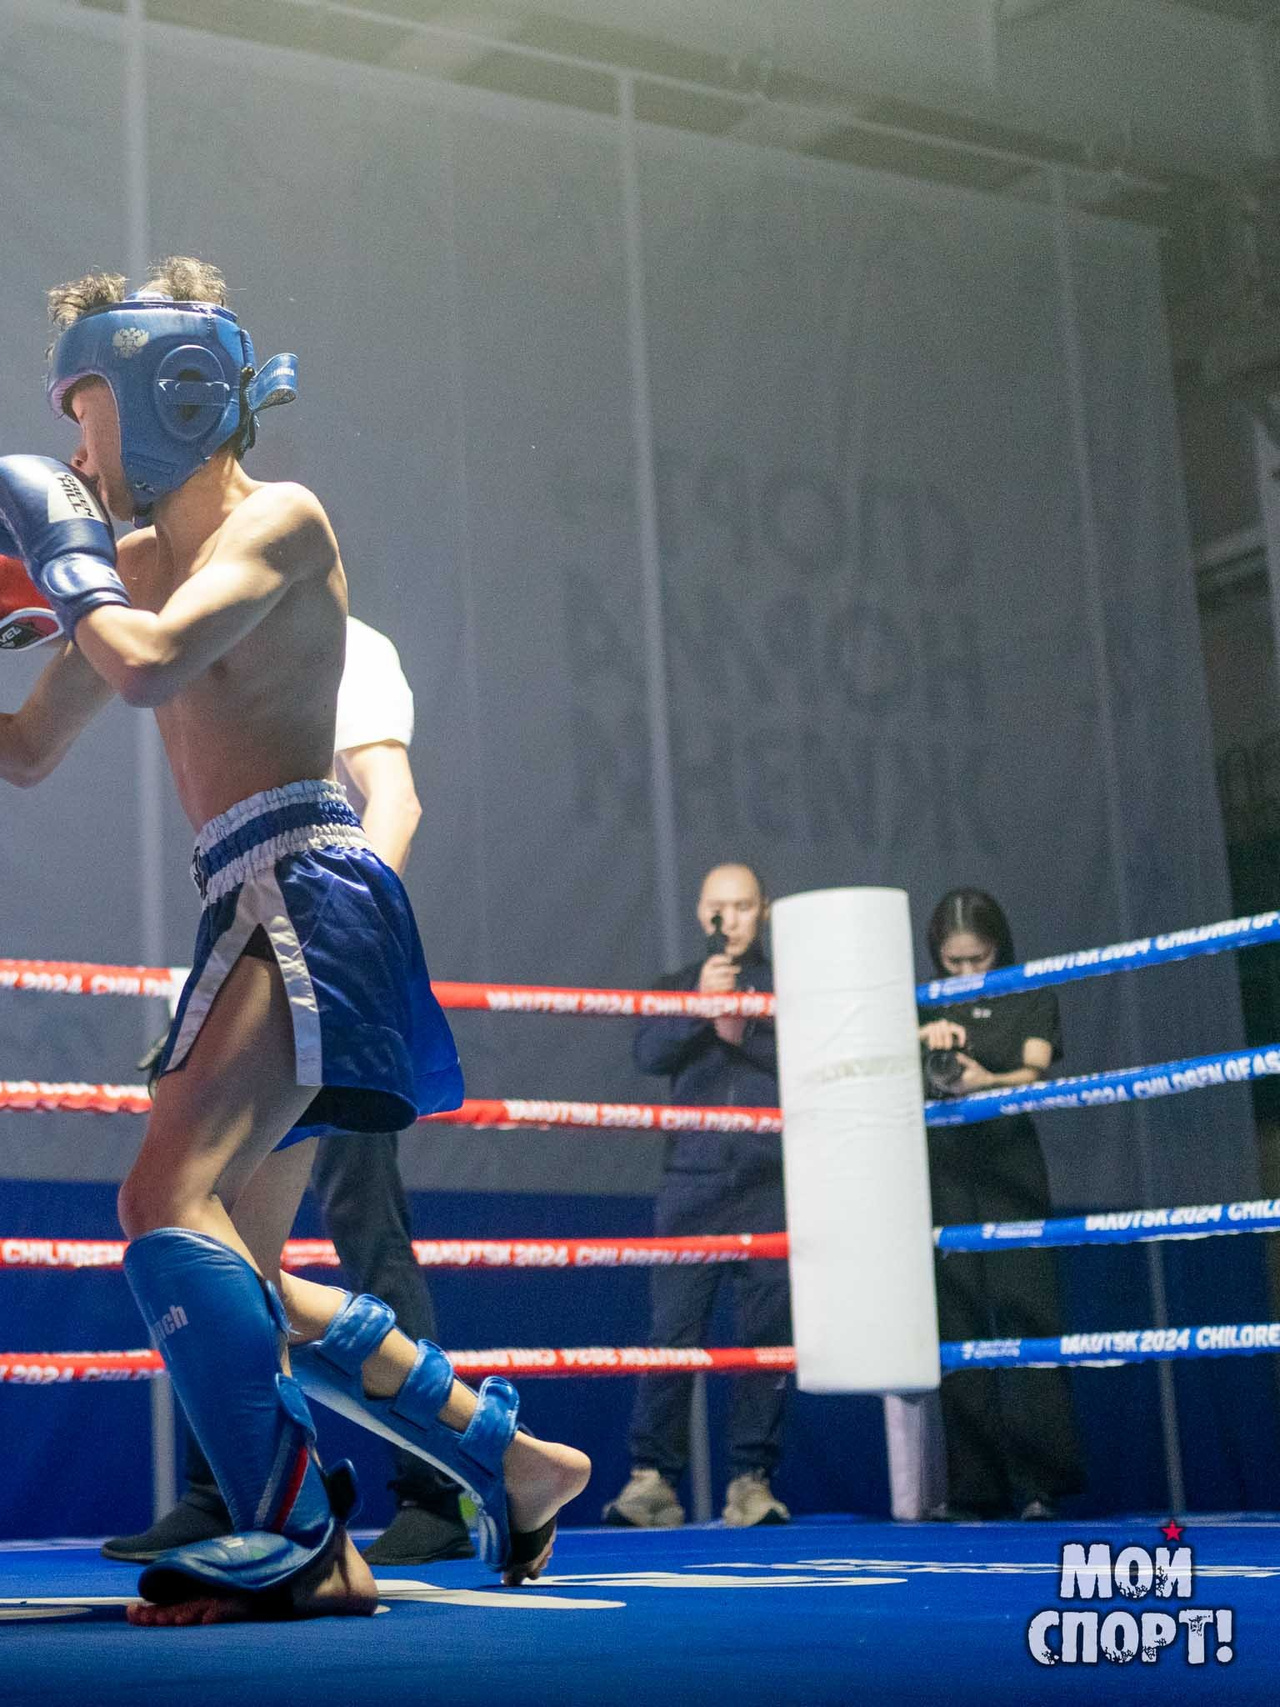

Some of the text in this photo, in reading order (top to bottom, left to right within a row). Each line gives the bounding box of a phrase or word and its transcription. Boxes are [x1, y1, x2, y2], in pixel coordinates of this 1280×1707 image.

[56, 477, 81, 513] HILL
[64, 474, 95, 517] GREEN
[1140, 1327, 1191, 1353] 2024
